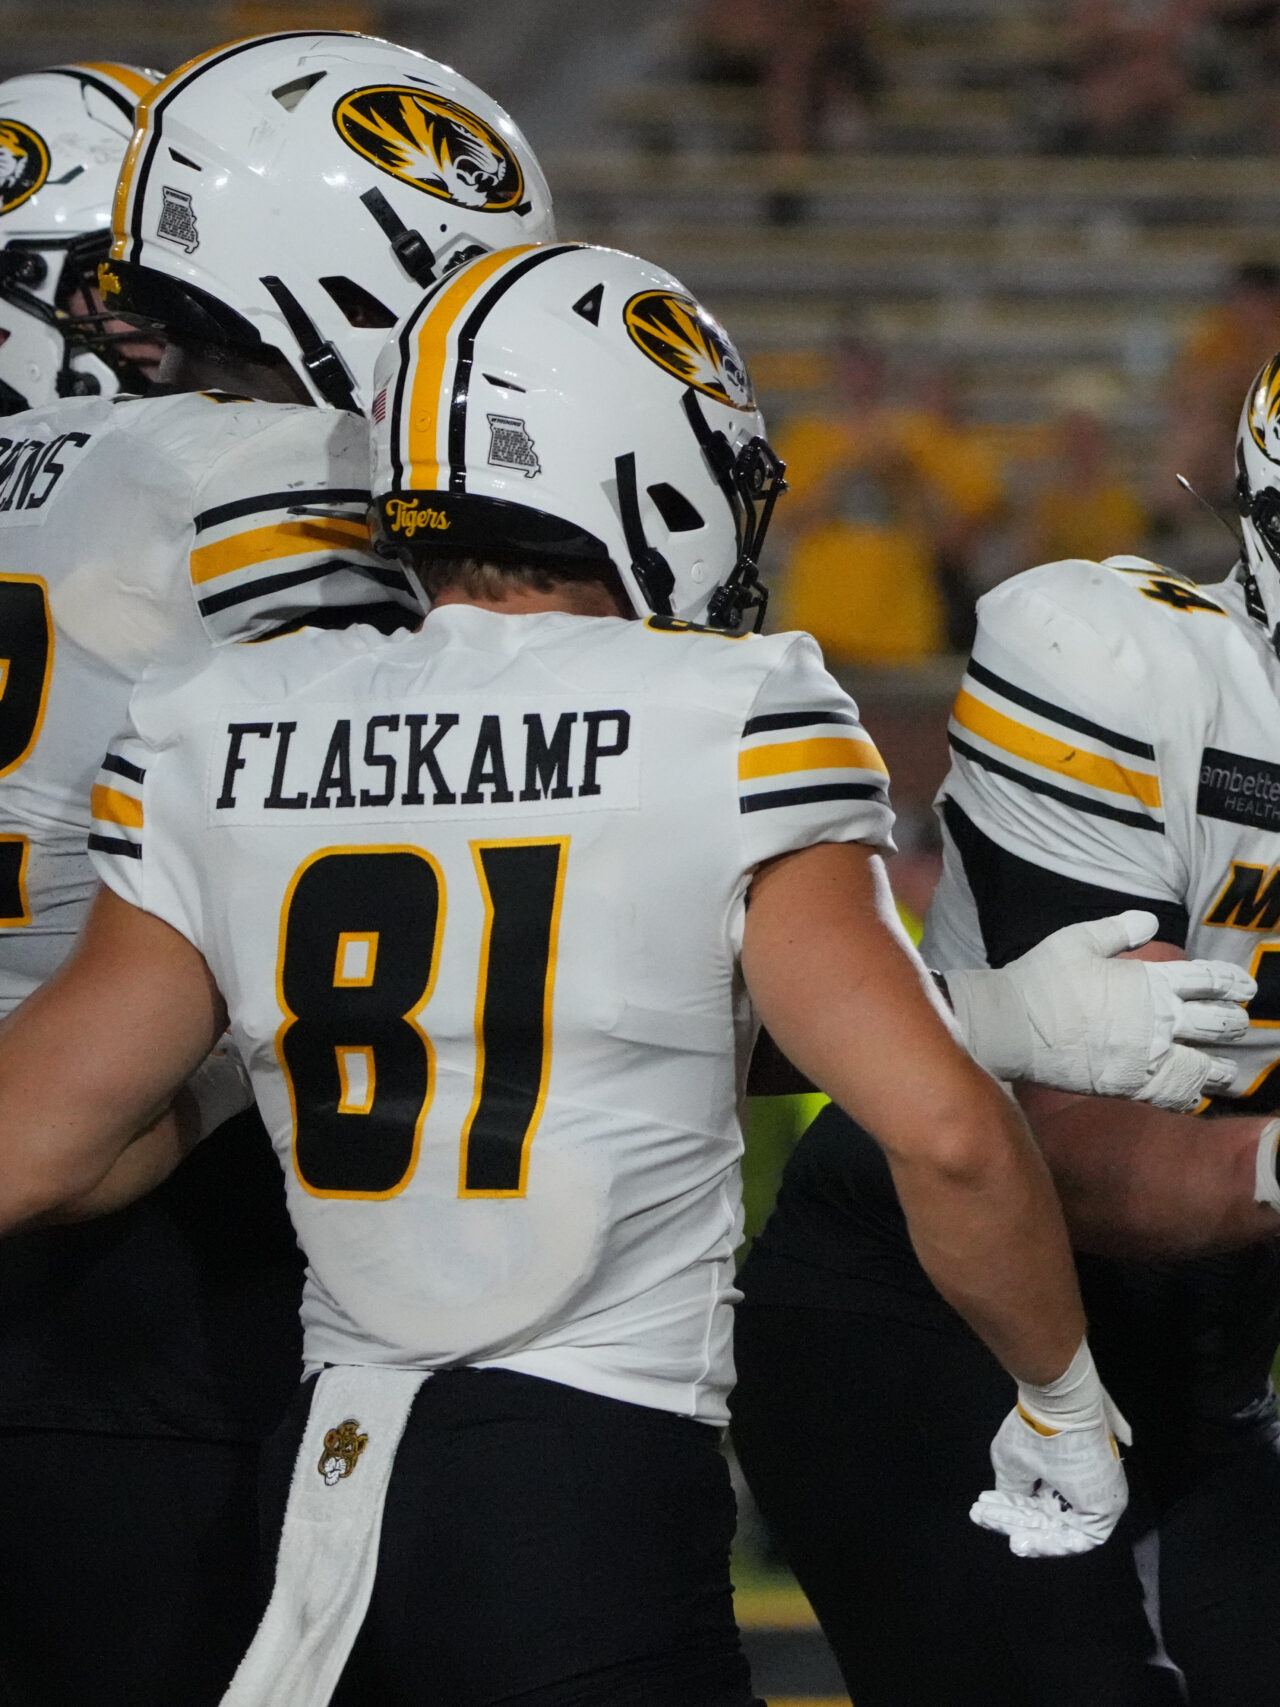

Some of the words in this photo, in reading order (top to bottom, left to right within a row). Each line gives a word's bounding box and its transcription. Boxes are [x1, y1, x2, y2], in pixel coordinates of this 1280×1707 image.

[385, 497, 452, 537] Tigers
[215, 709, 632, 810] FLASKAMP
[275, 834, 572, 1201] 81
